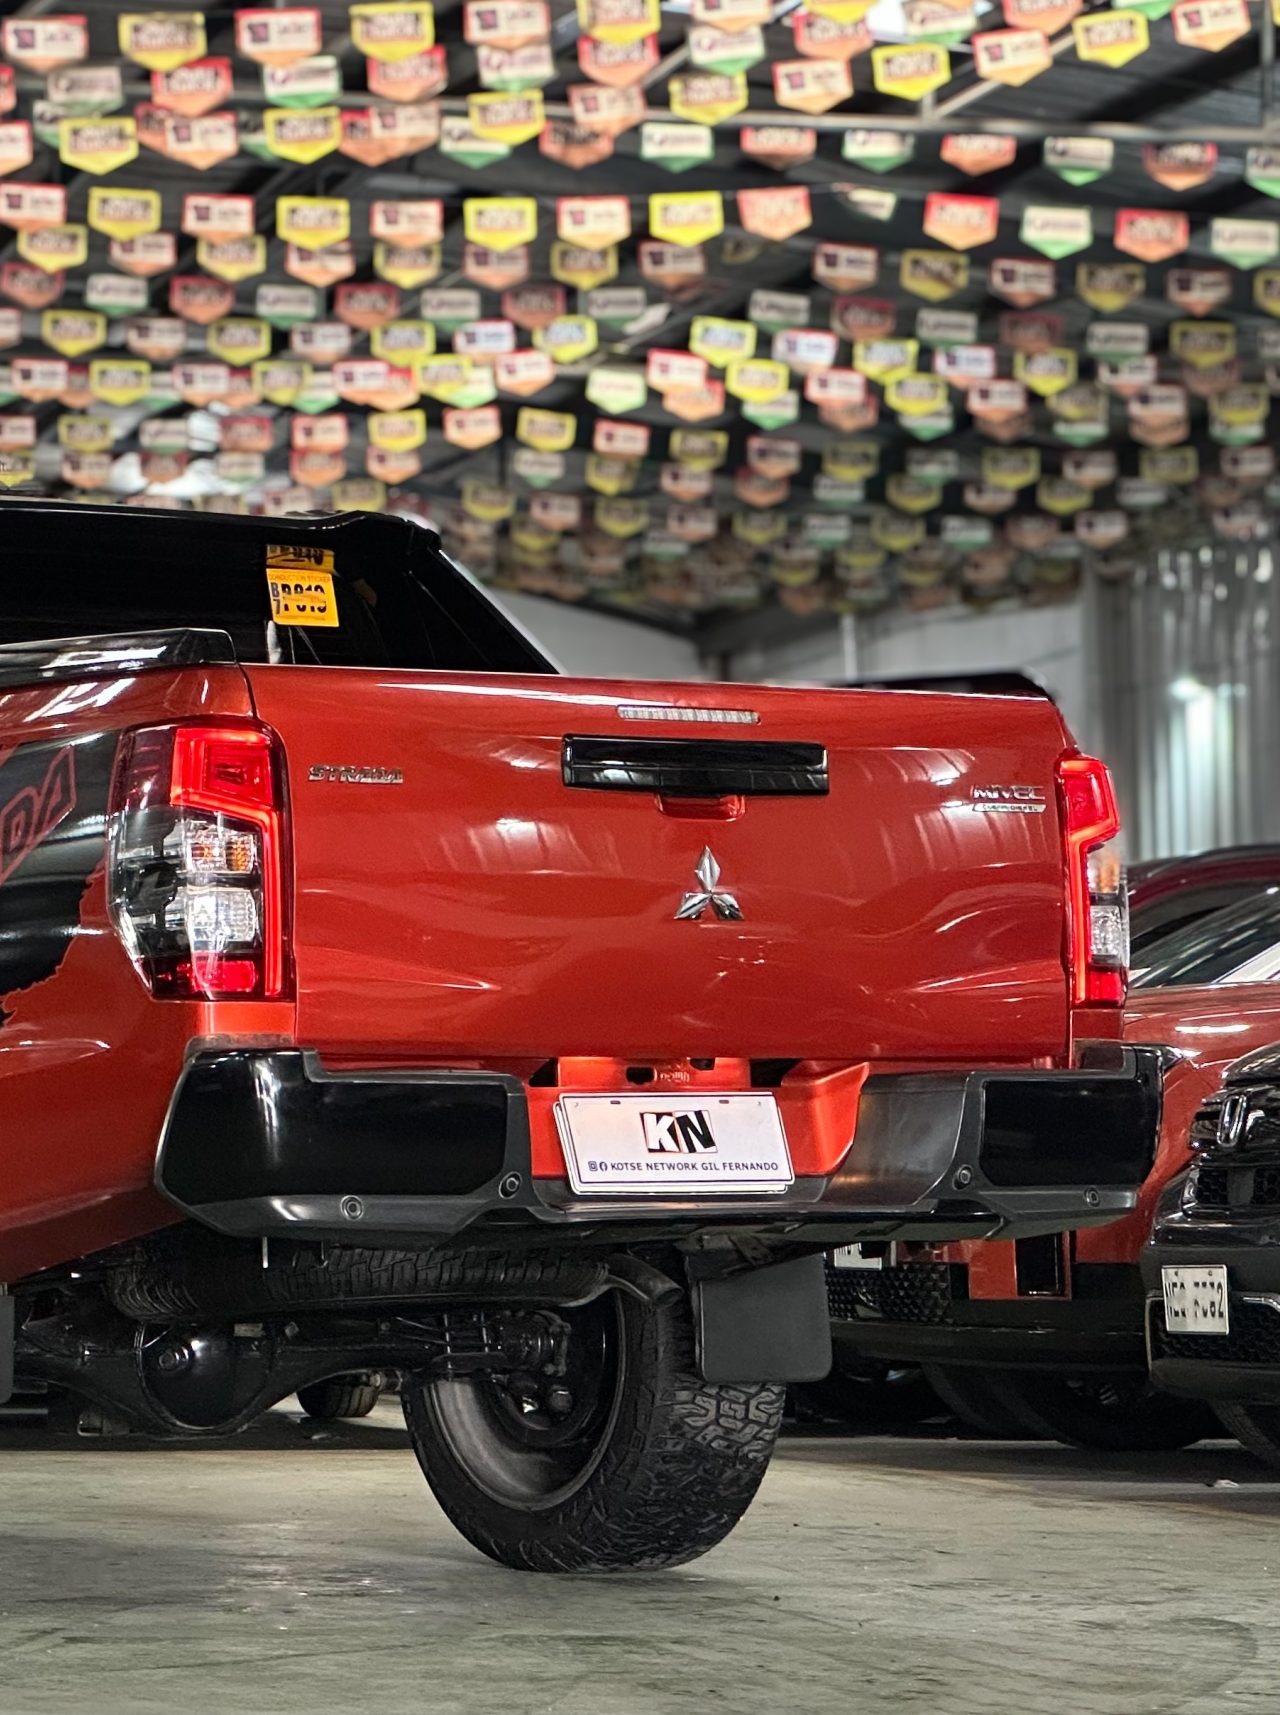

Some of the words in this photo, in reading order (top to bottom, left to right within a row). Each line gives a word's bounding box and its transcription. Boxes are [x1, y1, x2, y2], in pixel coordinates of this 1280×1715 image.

[308, 764, 404, 784] STRADA
[639, 1110, 718, 1153] KN
[611, 1161, 643, 1171] KOTSE
[646, 1161, 699, 1171] NETWORK
[701, 1161, 720, 1171] GIL
[723, 1161, 779, 1171] FERNANDO
